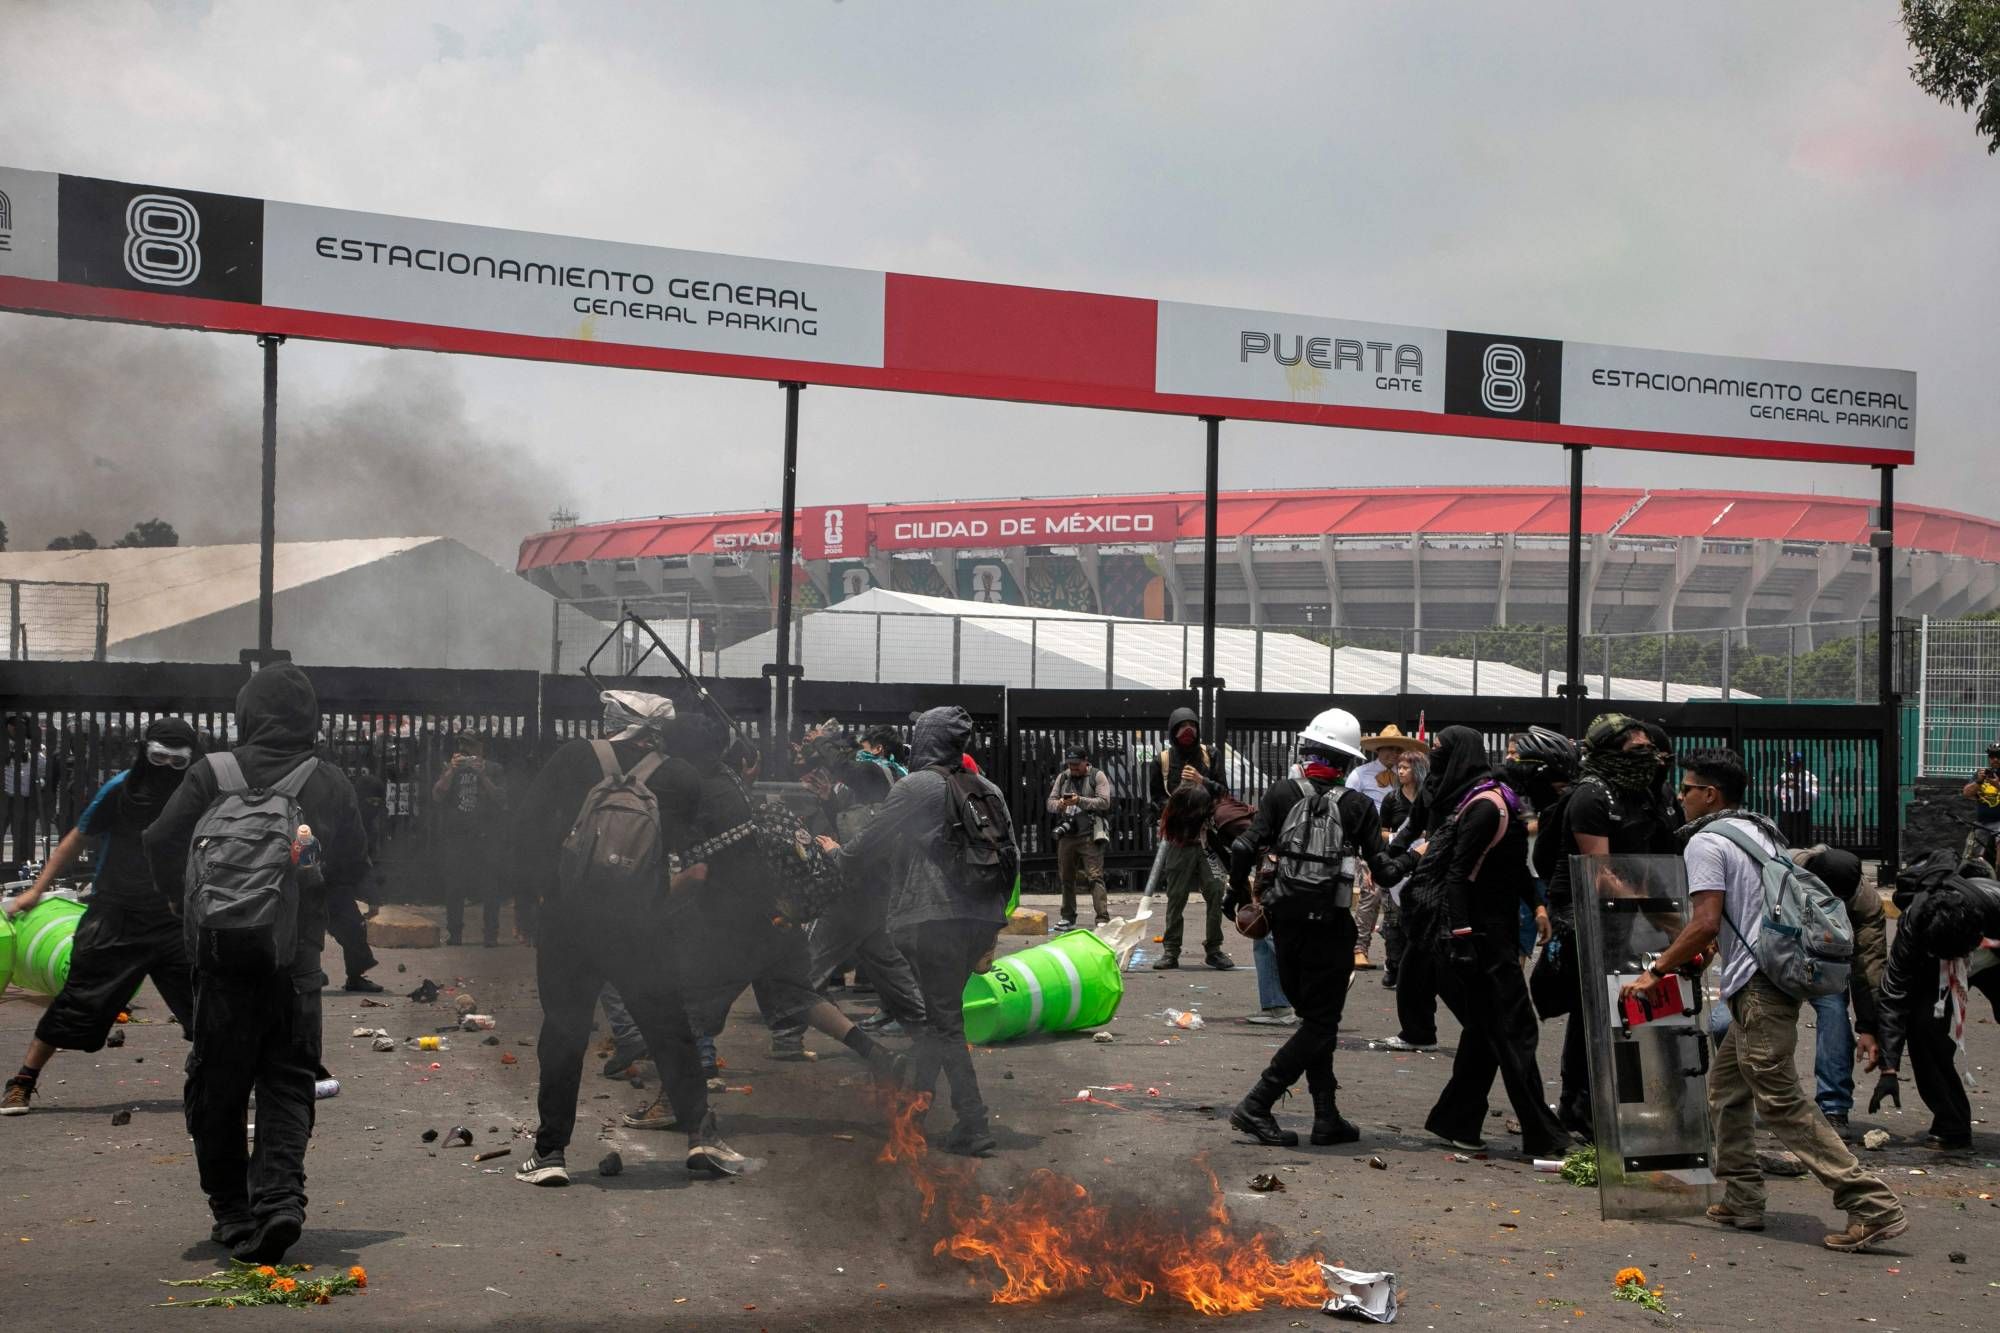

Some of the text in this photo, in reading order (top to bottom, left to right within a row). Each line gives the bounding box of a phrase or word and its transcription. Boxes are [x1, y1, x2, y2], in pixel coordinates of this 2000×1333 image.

[123, 193, 202, 287] 8
[315, 236, 819, 312] ESTACIONAMIENTO GENERAL
[573, 297, 819, 337] GENERAL PARKING
[1240, 330, 1424, 377] PUERTA
[1375, 376, 1423, 393] GATE
[1481, 343, 1526, 413] 8
[1591, 368, 1910, 411] ESTACIONAMIENTO GENERAL
[1749, 405, 1909, 430] GENERAL PARKING
[713, 531, 782, 548] ESTADI
[894, 512, 1154, 540] CIUDAD DE MÉXICO
